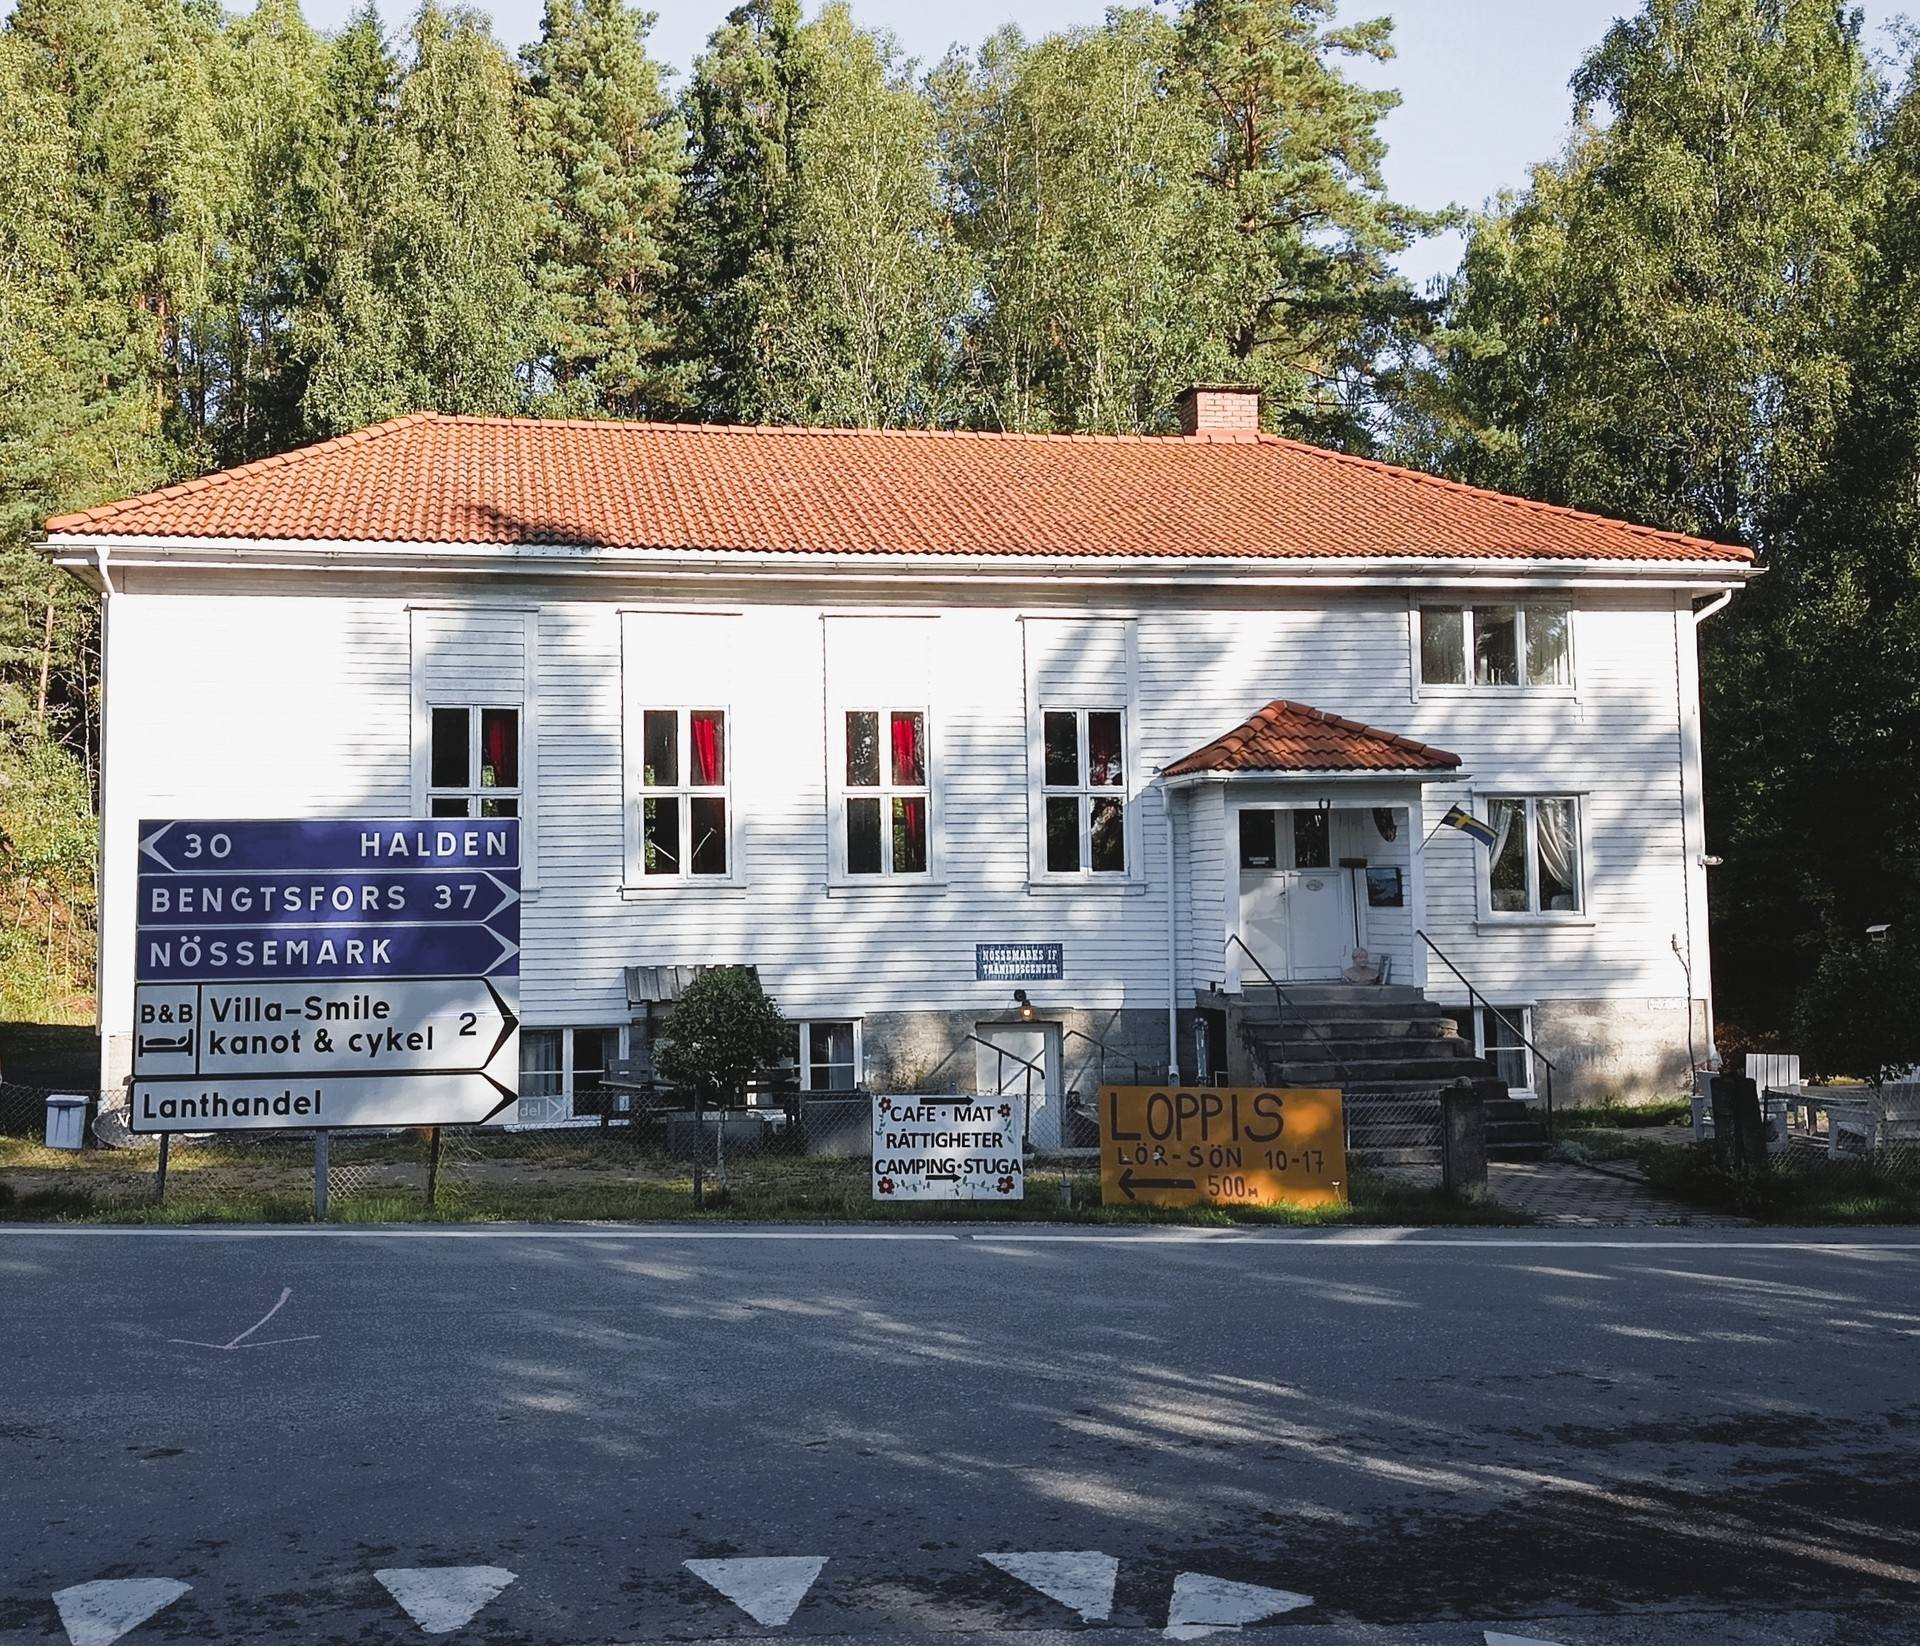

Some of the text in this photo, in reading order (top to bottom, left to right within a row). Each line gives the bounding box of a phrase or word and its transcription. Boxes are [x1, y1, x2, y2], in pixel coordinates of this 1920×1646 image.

[184, 831, 507, 859] 30 HALDEN
[151, 884, 477, 913] BENGTSFORS 37
[150, 936, 391, 967] NÖSSEMARK
[141, 1004, 193, 1024] B&B
[210, 995, 390, 1023] Villa-Smile
[459, 1012, 477, 1036] 2
[209, 1026, 433, 1058] kanot & cykel
[143, 1090, 321, 1119] Lanthandel
[890, 1106, 995, 1122] CAFE MAT
[1110, 1092, 1284, 1142] LOPPIS
[886, 1128, 1003, 1149] RÄTTIGHETER
[1264, 1151, 1324, 1174] 10-17
